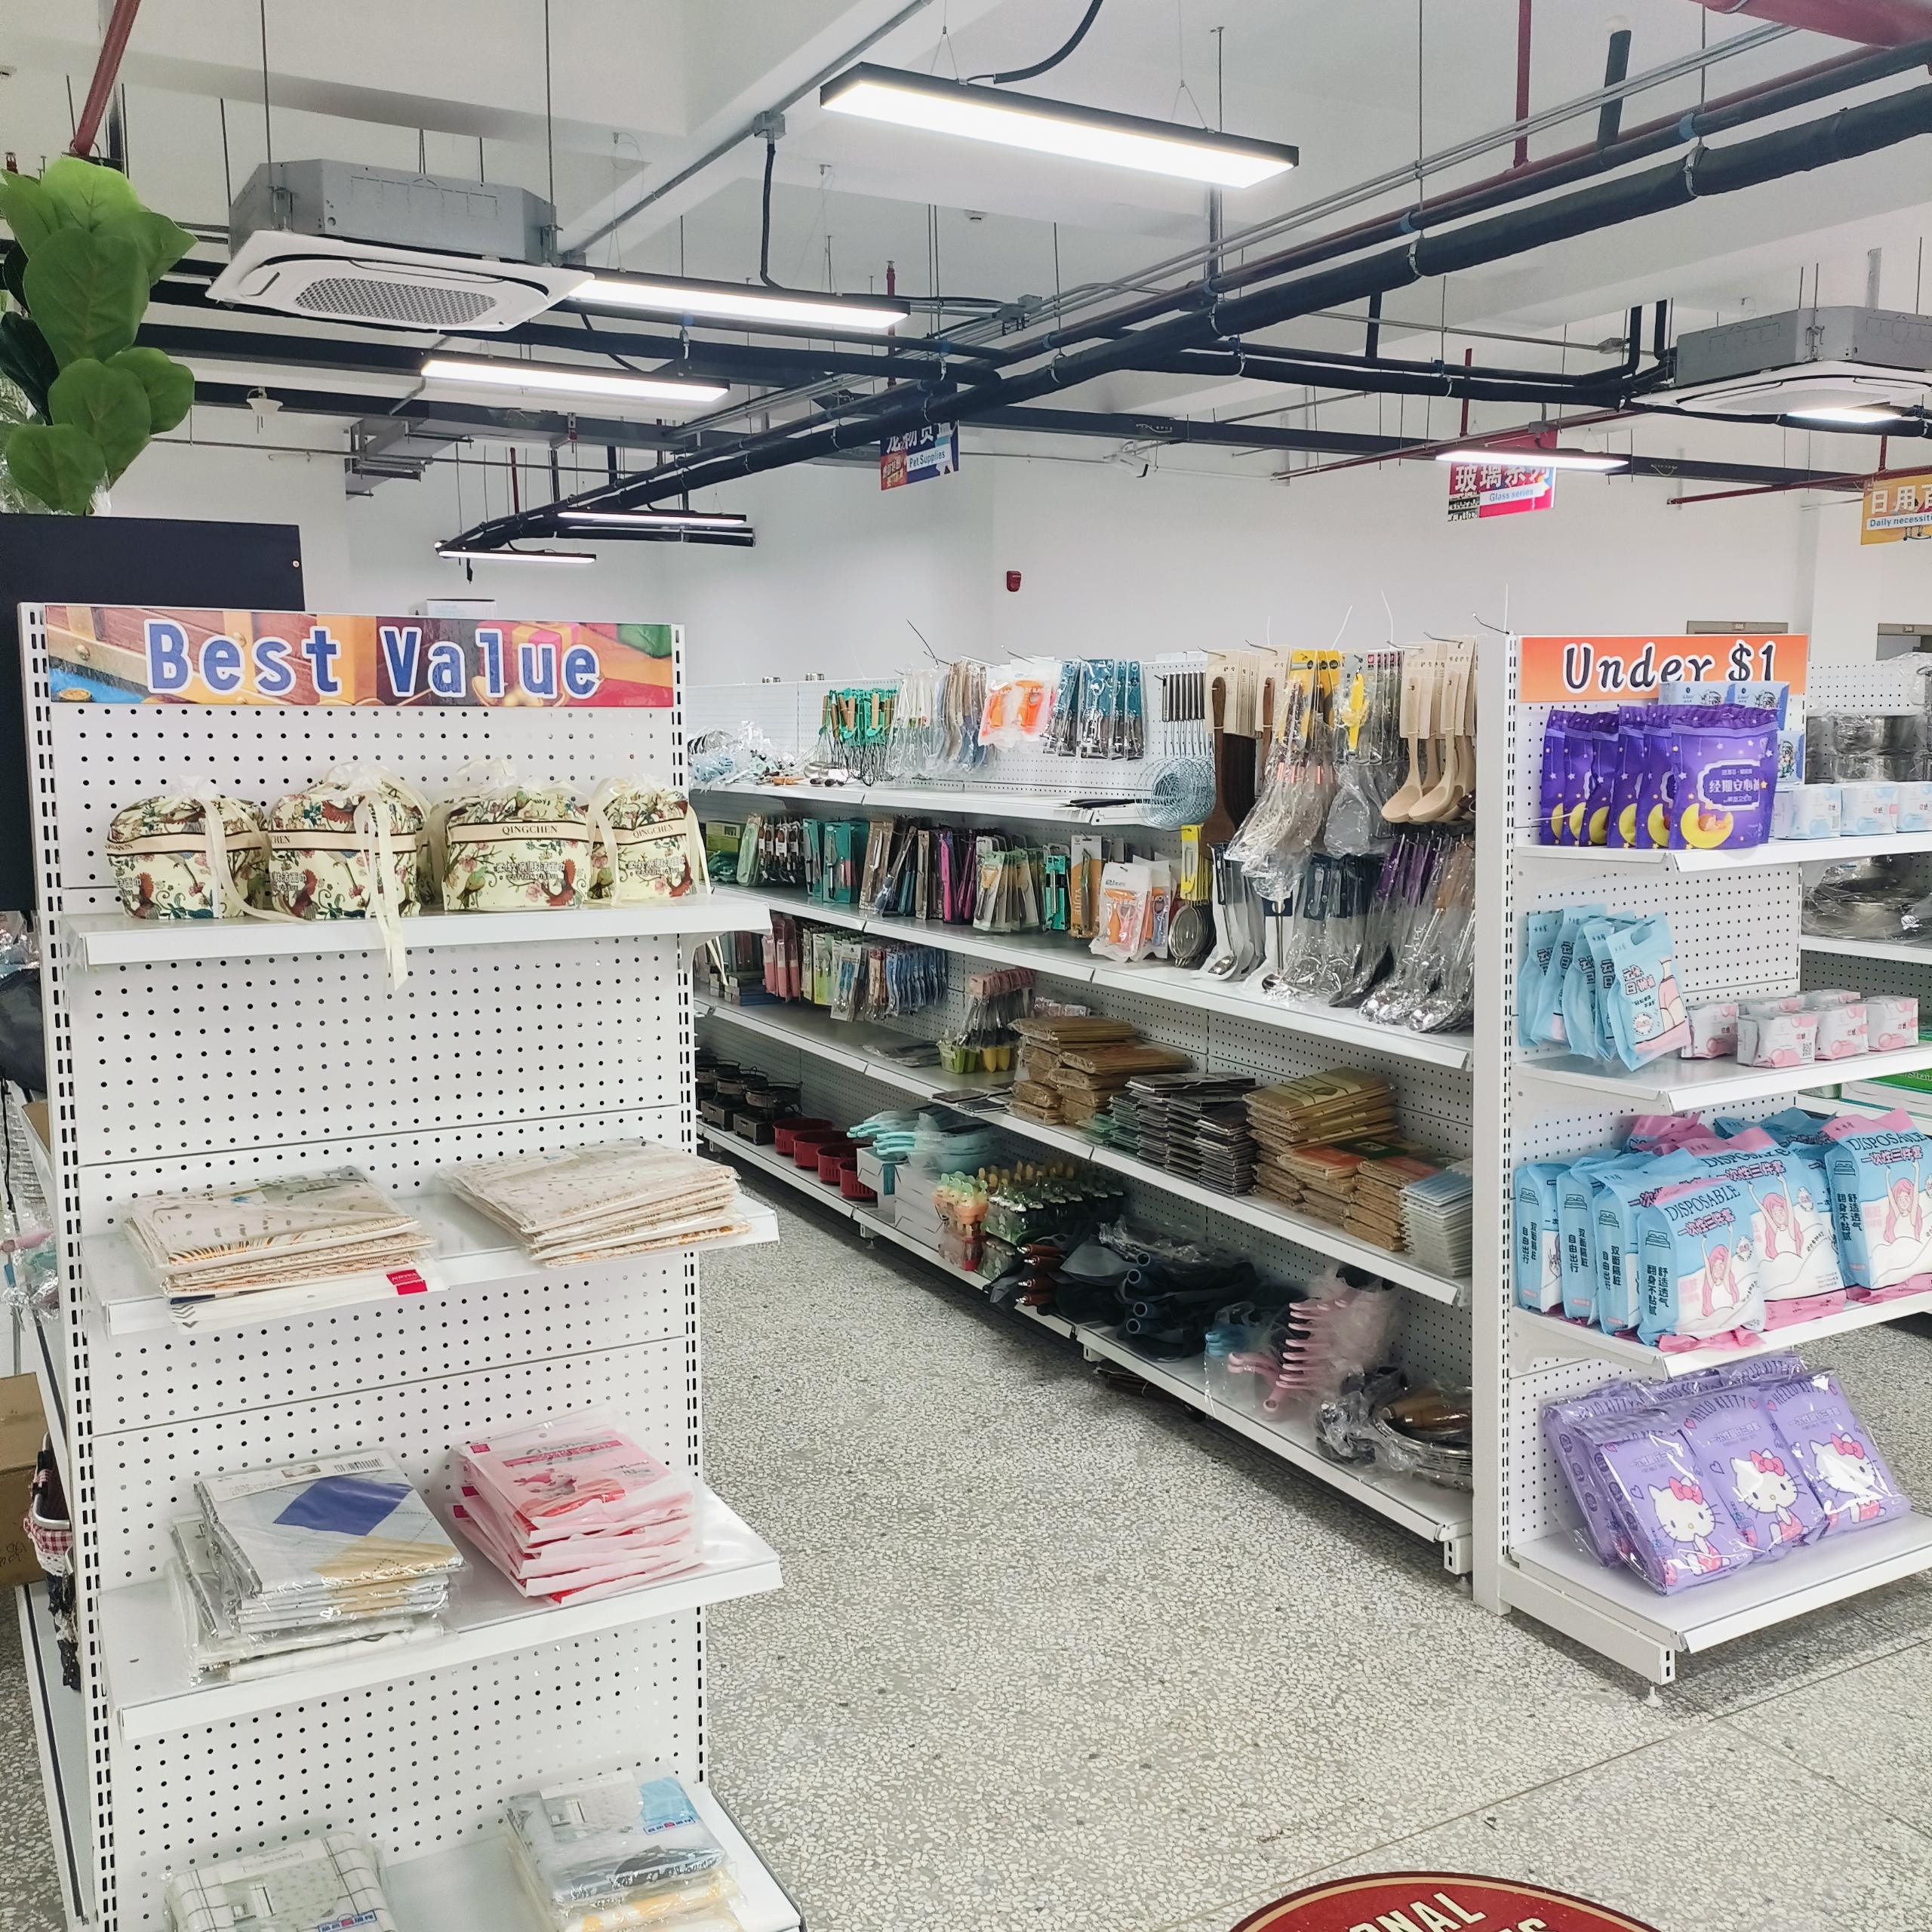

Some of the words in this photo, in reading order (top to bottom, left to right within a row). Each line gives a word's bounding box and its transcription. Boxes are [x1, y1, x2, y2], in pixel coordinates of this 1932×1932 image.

[909, 457, 919, 468] Pet
[920, 451, 946, 466] Supplies
[1489, 491, 1510, 502] Glass
[1511, 488, 1534, 499] series
[1869, 518, 1892, 528] Daily
[145, 617, 344, 697] Best
[378, 623, 601, 700] Value
[1561, 641, 1715, 694] Under
[1727, 638, 1777, 681] $1
[502, 825, 558, 835] QINGCHEN
[632, 824, 674, 838] QINGCHEN
[1663, 1185, 1741, 1221] DISPOSABLE
[1847, 1193, 1863, 1232] 舒适透气
[1567, 1234, 1580, 1273] 自由出行
[1770, 1383, 1800, 1405] HELLO
[1691, 1400, 1717, 1423] HELLO
[1717, 1394, 1747, 1410] KITTY
